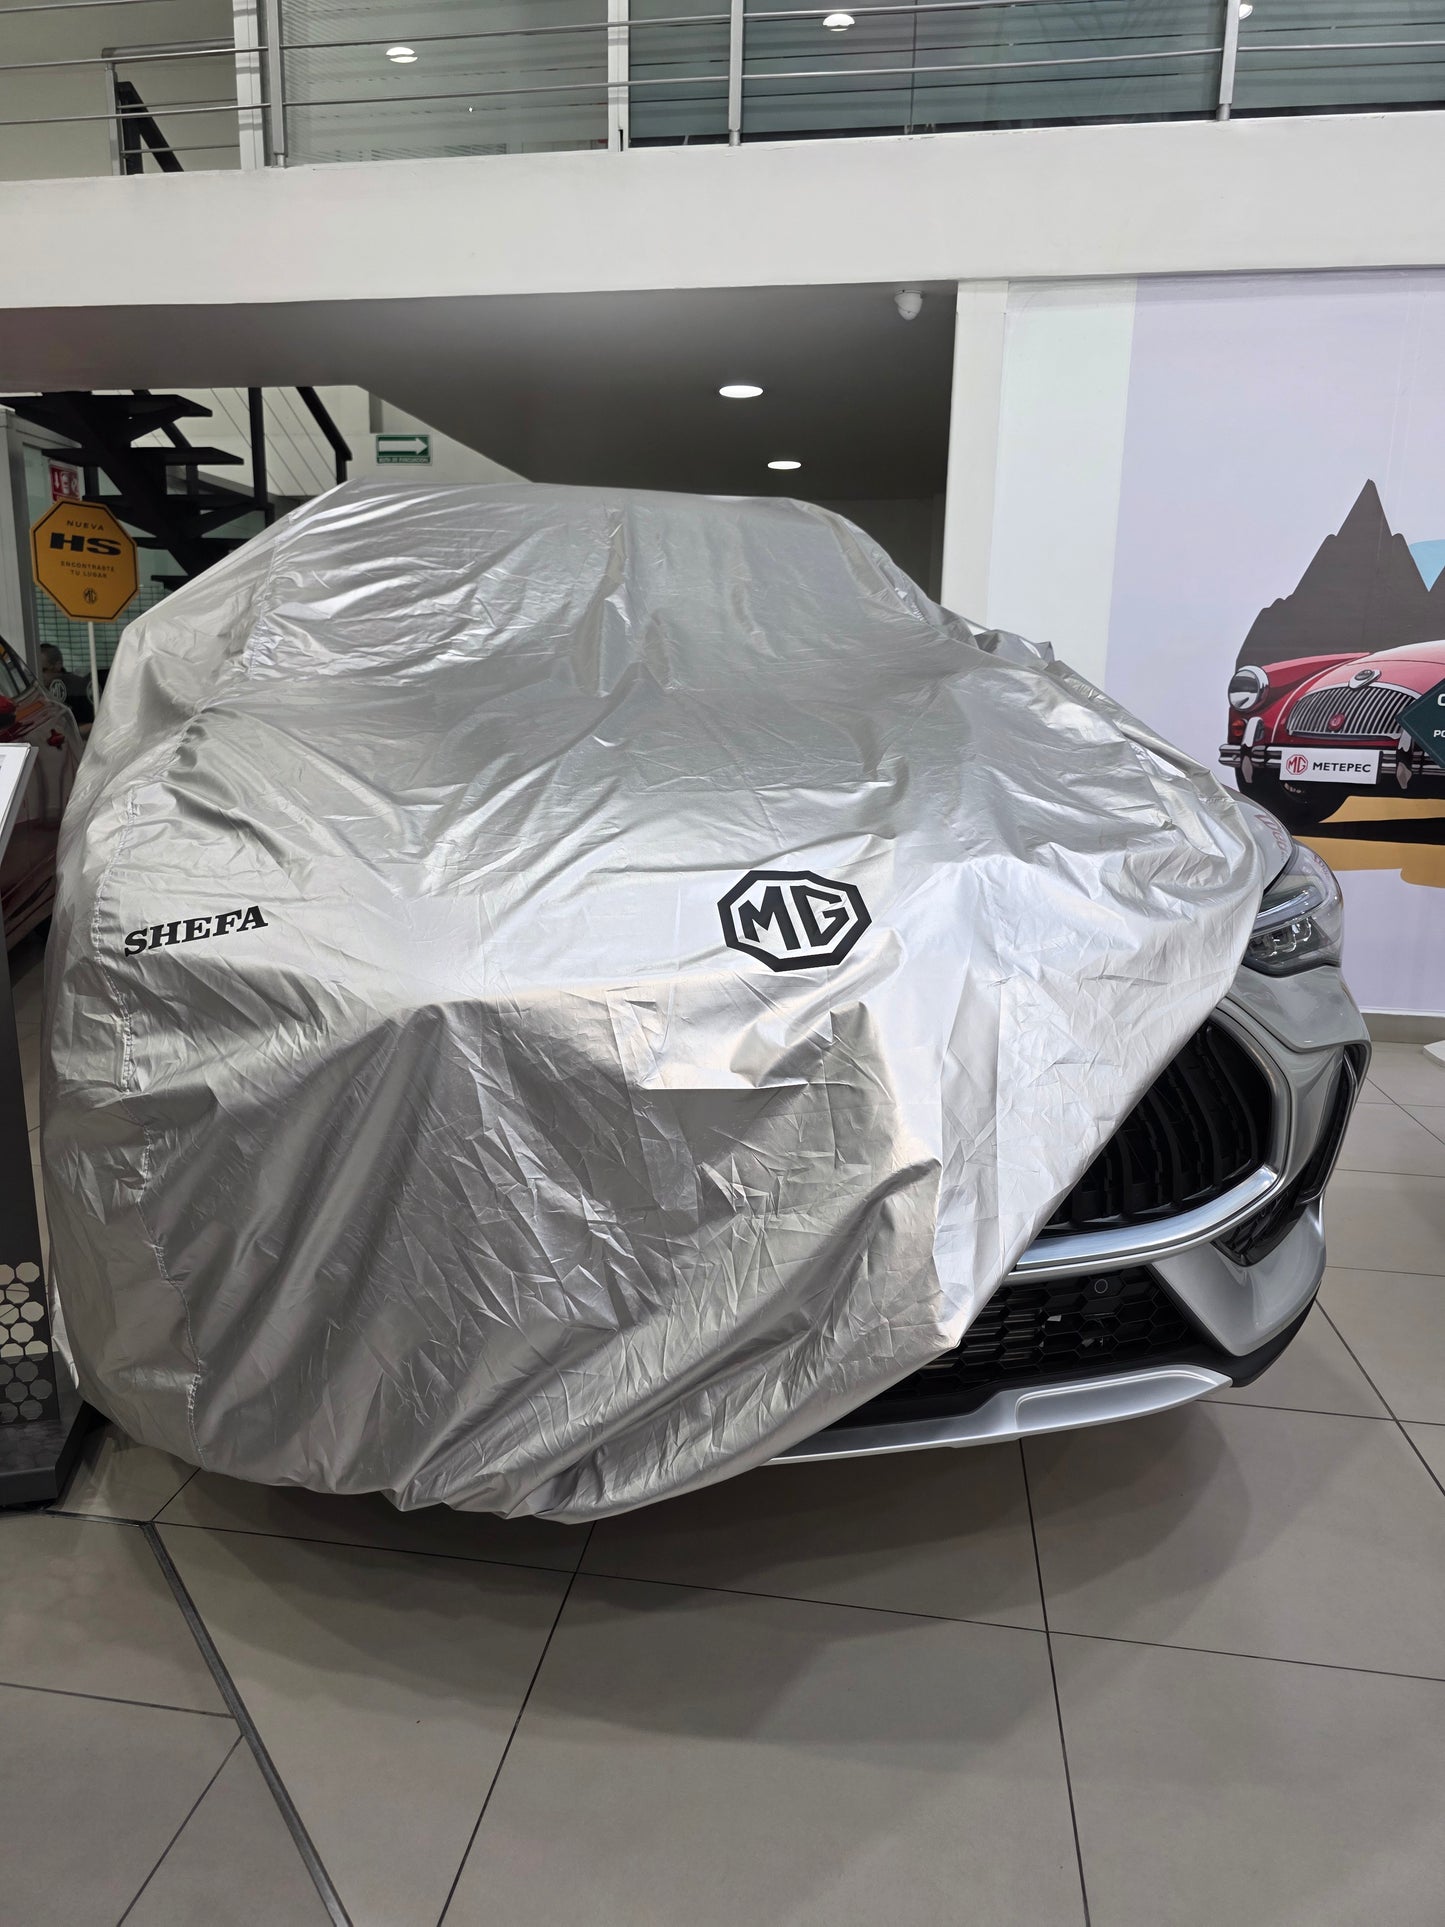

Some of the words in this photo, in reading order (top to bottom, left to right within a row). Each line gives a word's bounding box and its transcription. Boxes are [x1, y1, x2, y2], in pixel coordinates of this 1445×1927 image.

[66, 520, 105, 531] NUEVA
[50, 532, 122, 556] HS
[60, 560, 115, 572] ENCONTRASTE
[83, 570, 107, 578] LUGAR
[1287, 755, 1308, 774] MG
[1312, 762, 1371, 773] METEPEC
[735, 883, 852, 953] MG
[124, 905, 269, 957] SHEFA
